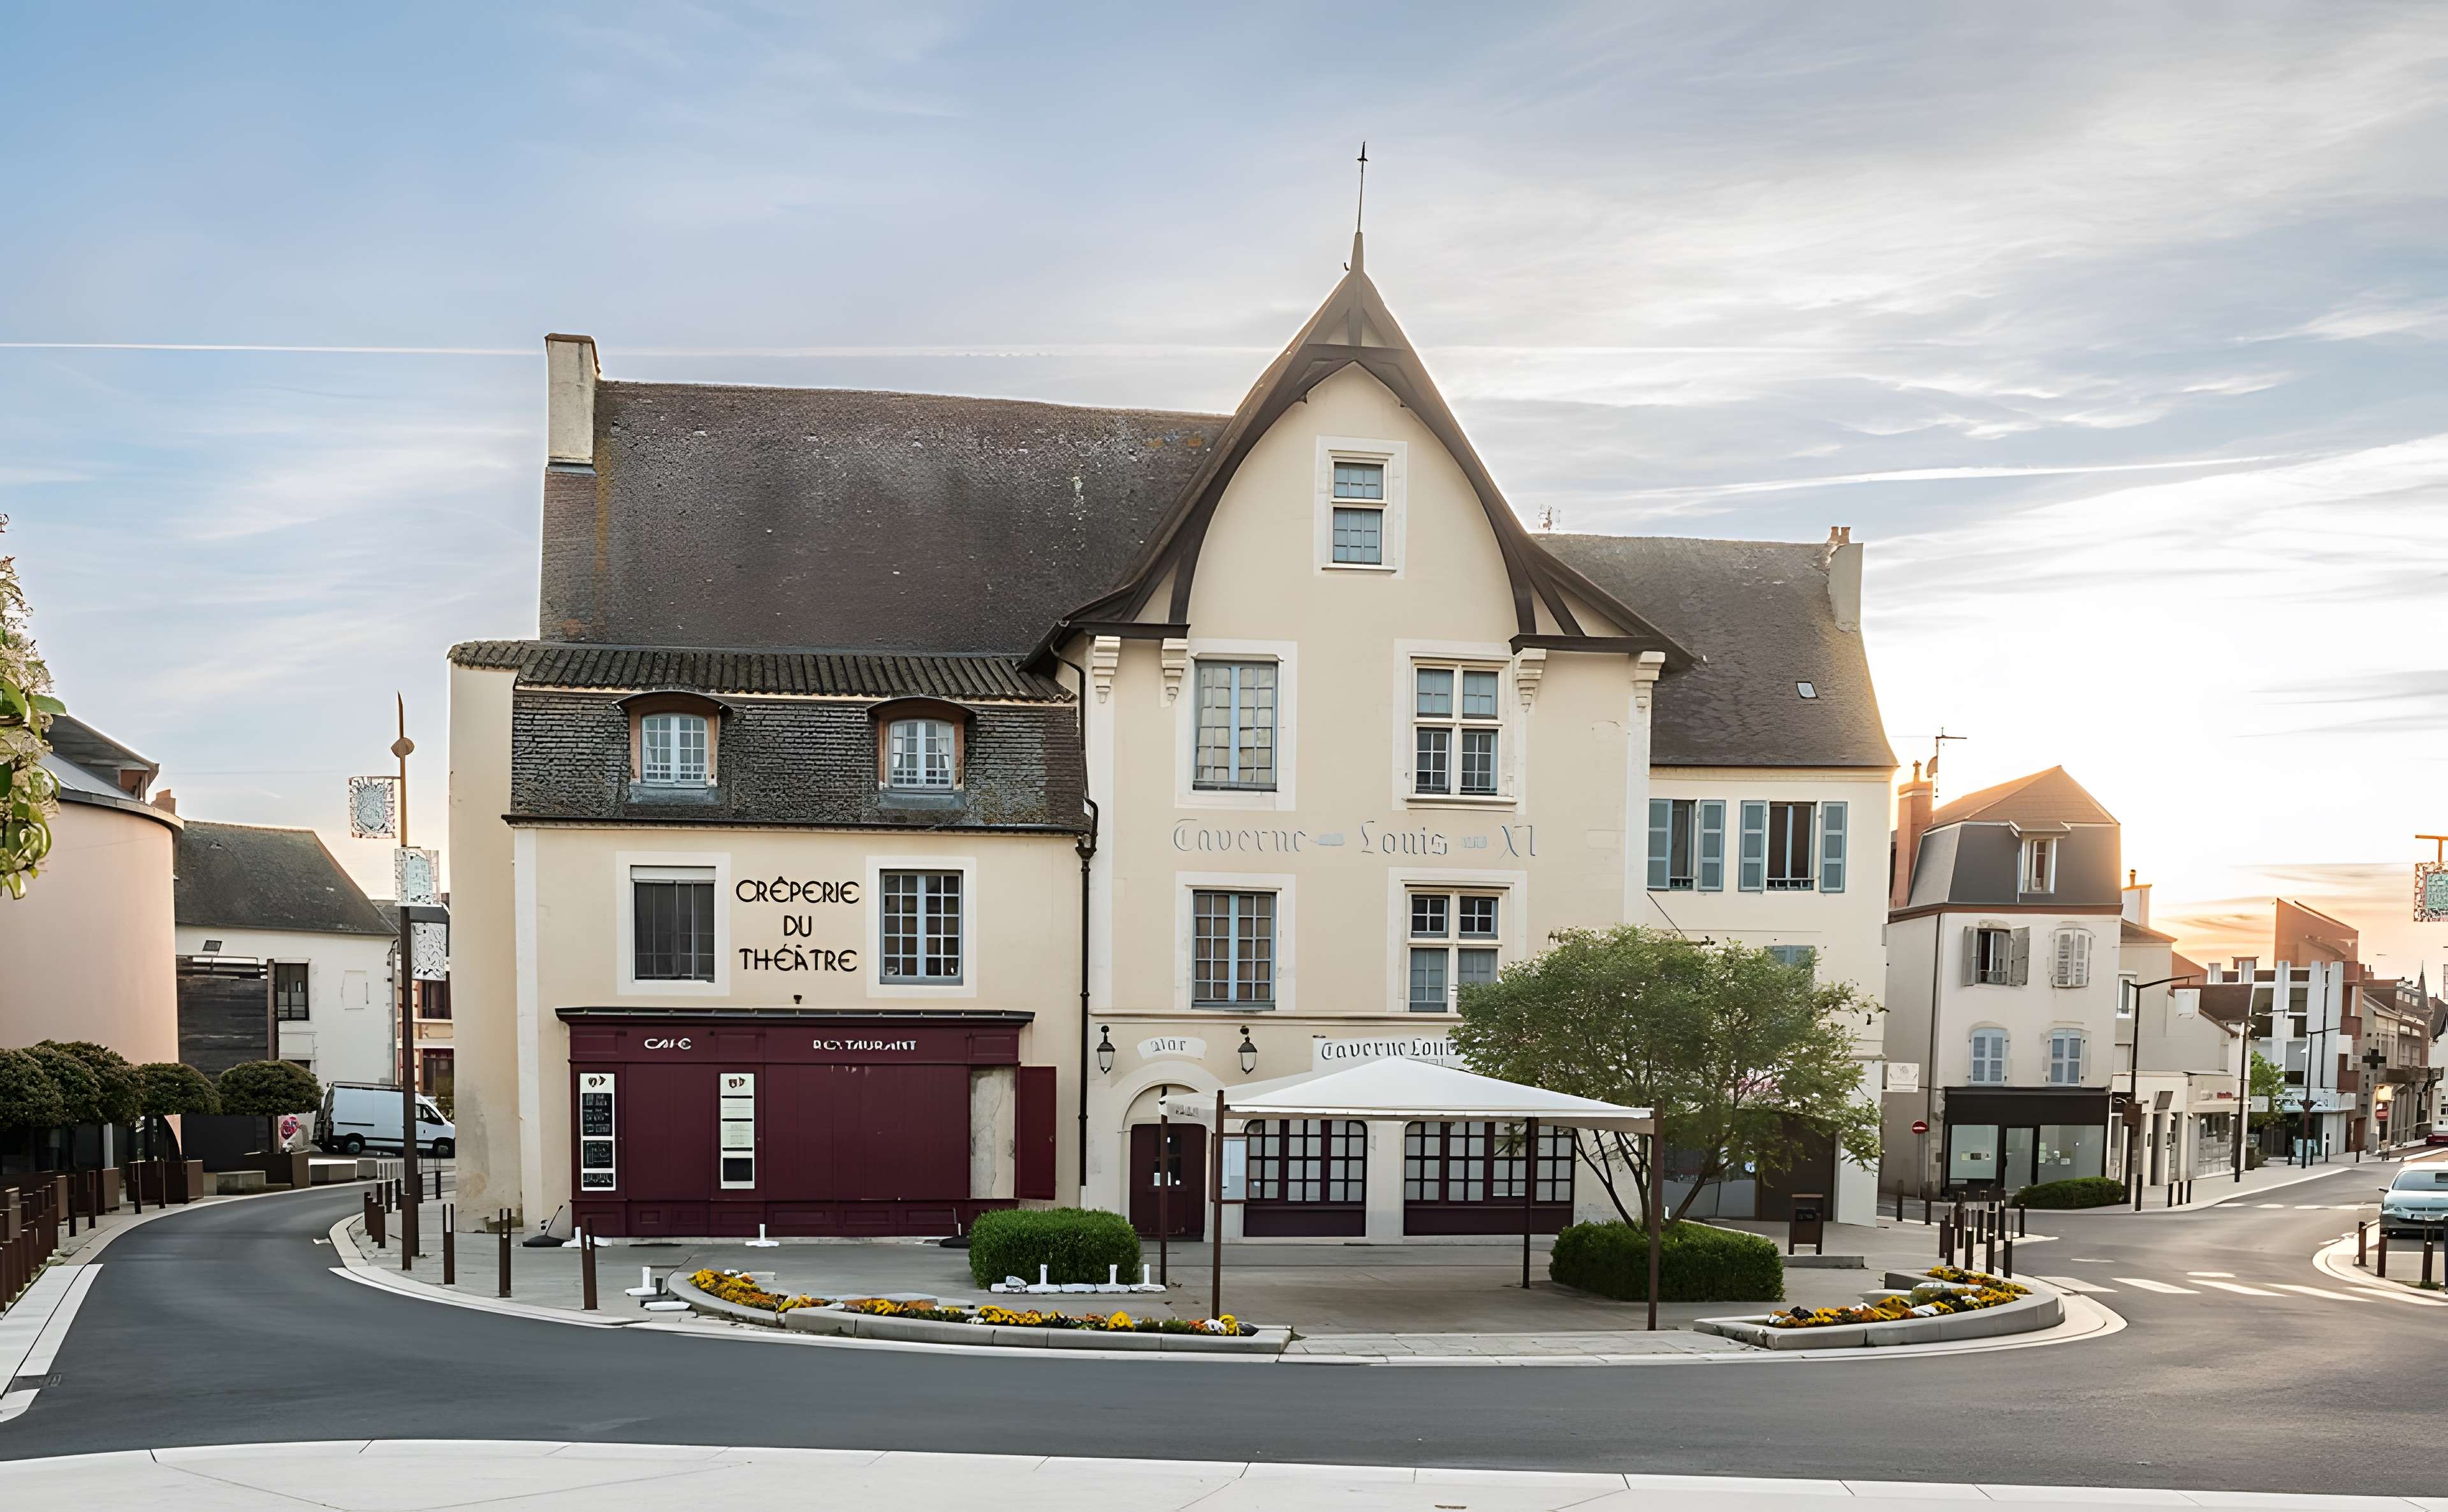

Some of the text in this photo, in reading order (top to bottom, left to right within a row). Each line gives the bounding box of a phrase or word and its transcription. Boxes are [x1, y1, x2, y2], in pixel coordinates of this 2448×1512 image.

[1173, 818, 1306, 852] Taverne
[1361, 820, 1447, 855] Louis
[736, 876, 859, 904] CRÊPERIE
[783, 915, 812, 937] DU
[738, 943, 857, 972] THÉÂTRE
[1321, 1042, 1406, 1060] Taverne
